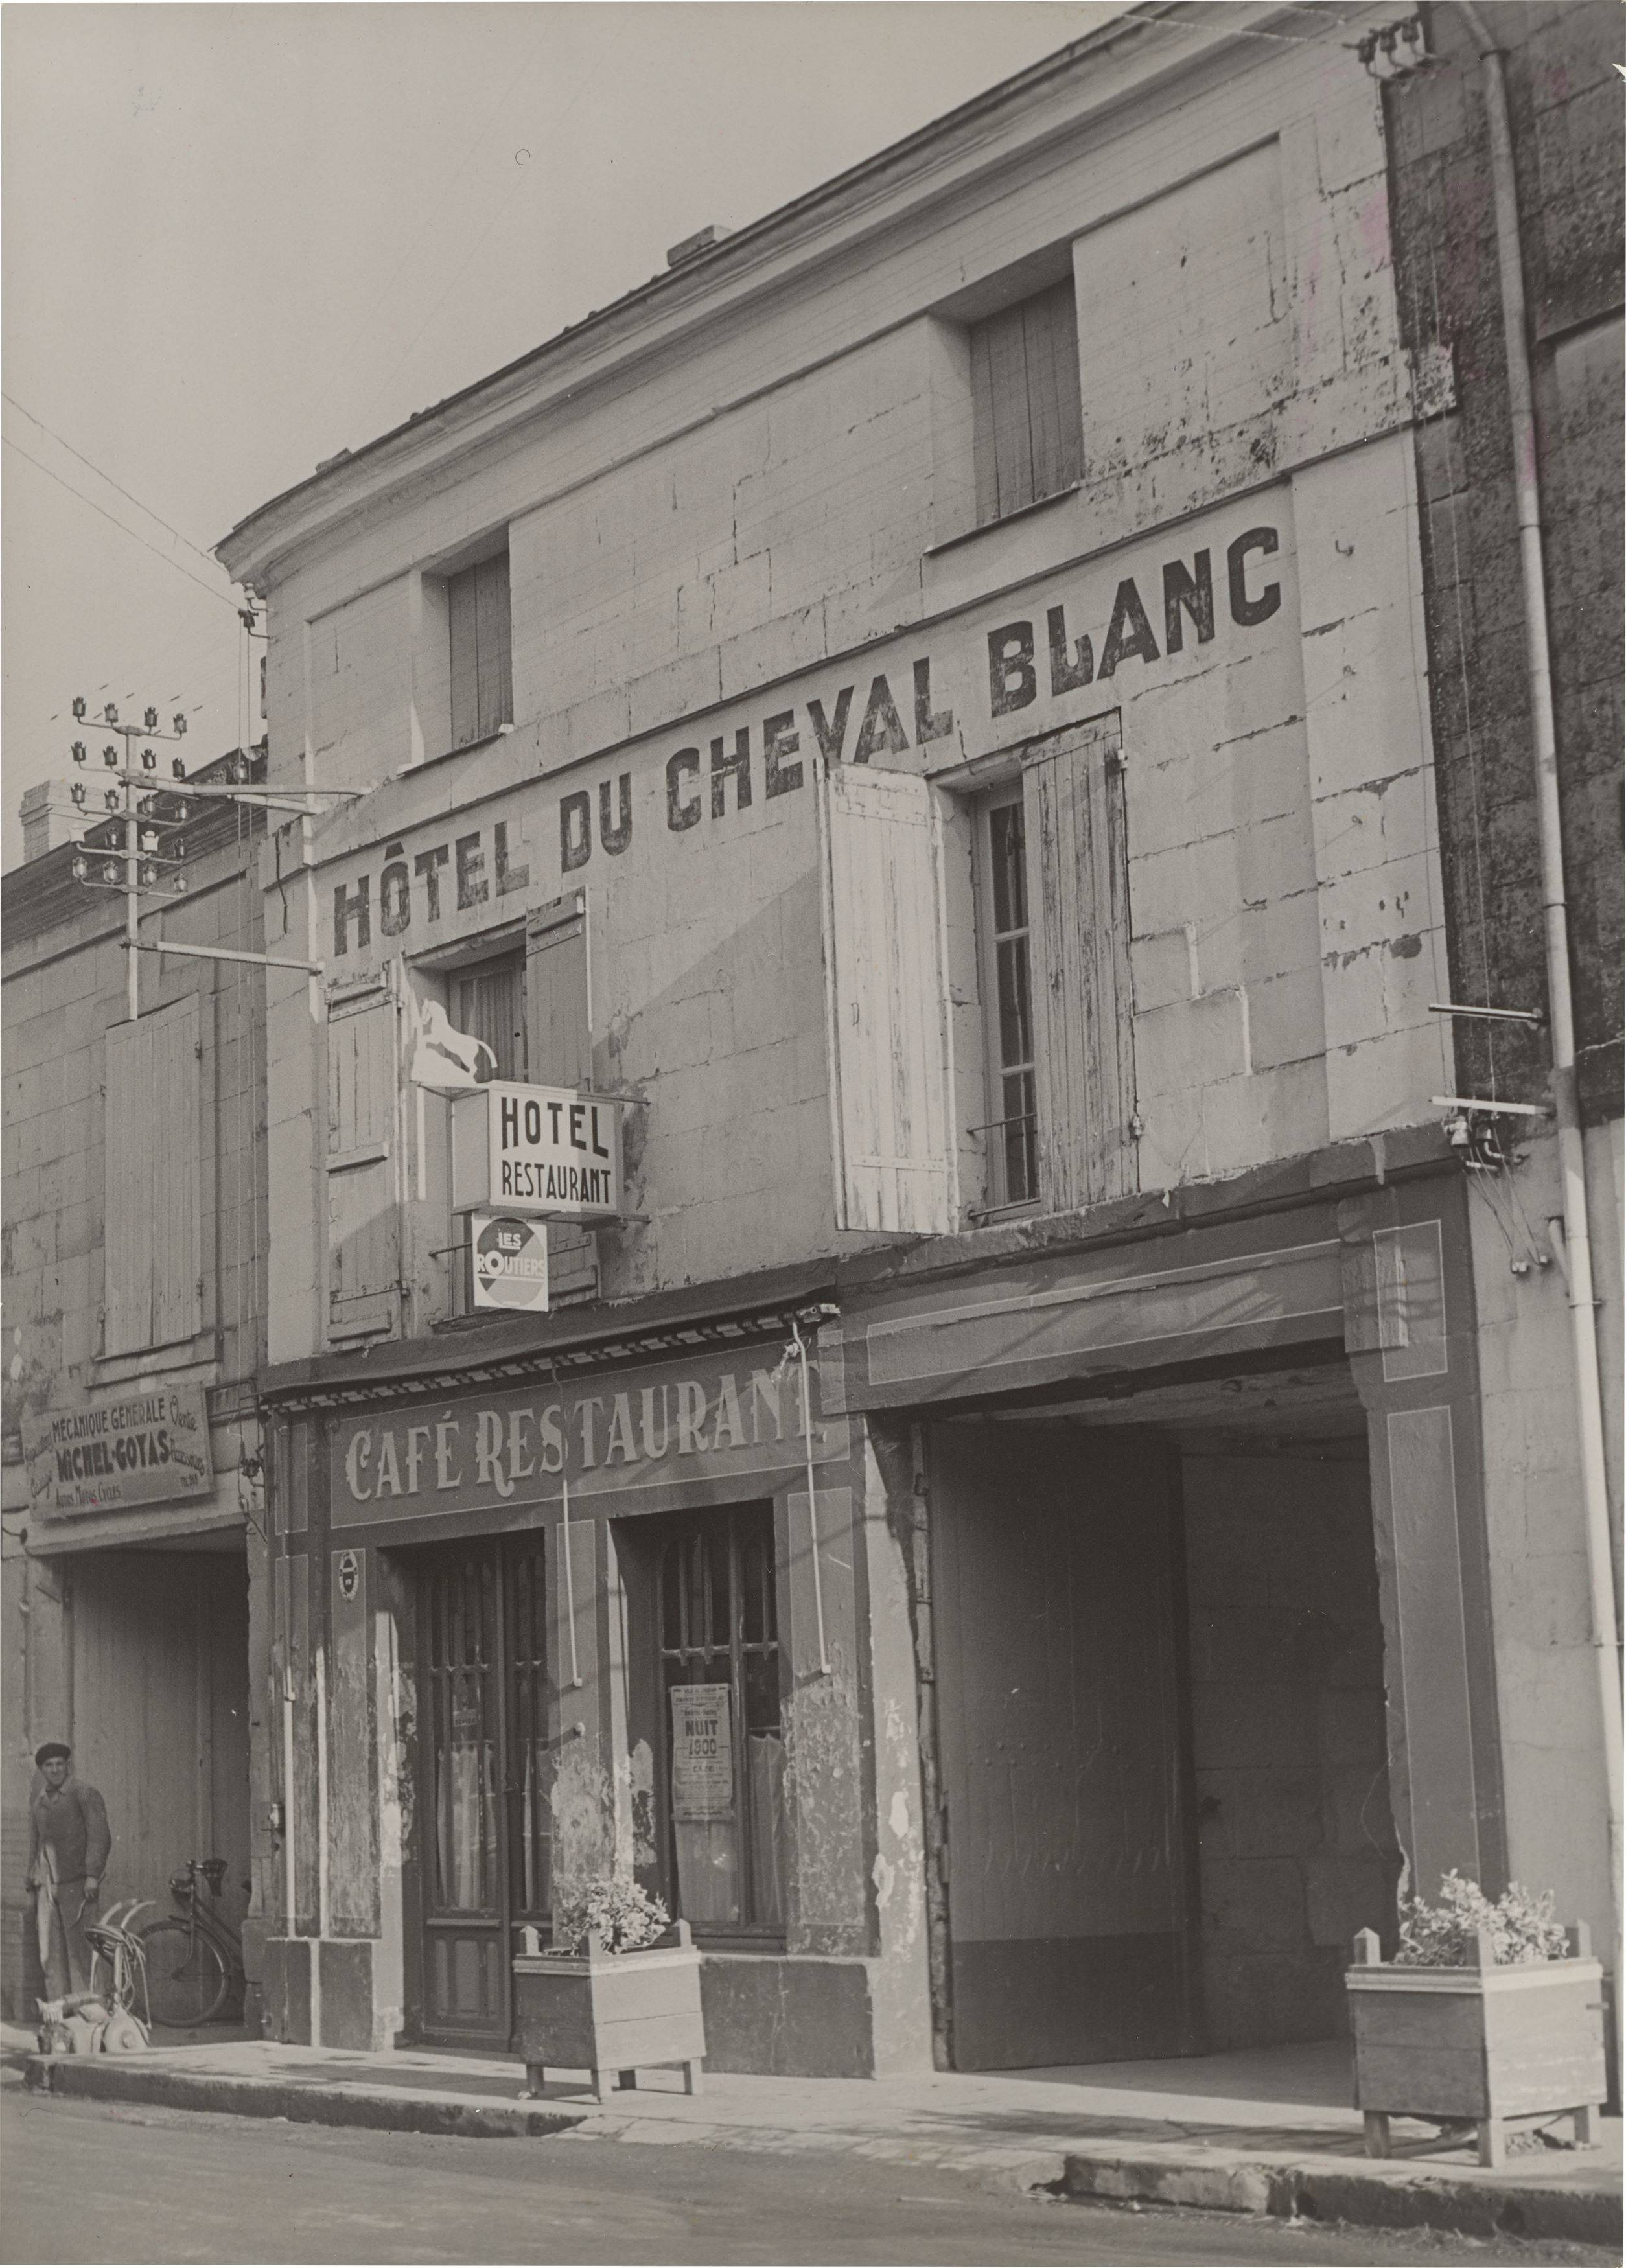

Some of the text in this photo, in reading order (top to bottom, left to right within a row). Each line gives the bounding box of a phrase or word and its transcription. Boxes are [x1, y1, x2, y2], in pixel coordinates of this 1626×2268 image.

[334, 526, 1281, 956] HÔTEL DU CHEVAL BLANC
[501, 1096, 609, 1159] HOTEL
[502, 1159, 611, 1205] RESTAURANT
[498, 1231, 522, 1250] LES
[477, 1250, 544, 1277] ROUTIERS
[345, 1360, 818, 1501] CAFÉ RESTAURANT
[685, 1719, 718, 1737] NUIT
[689, 1738, 717, 1755] 1900
